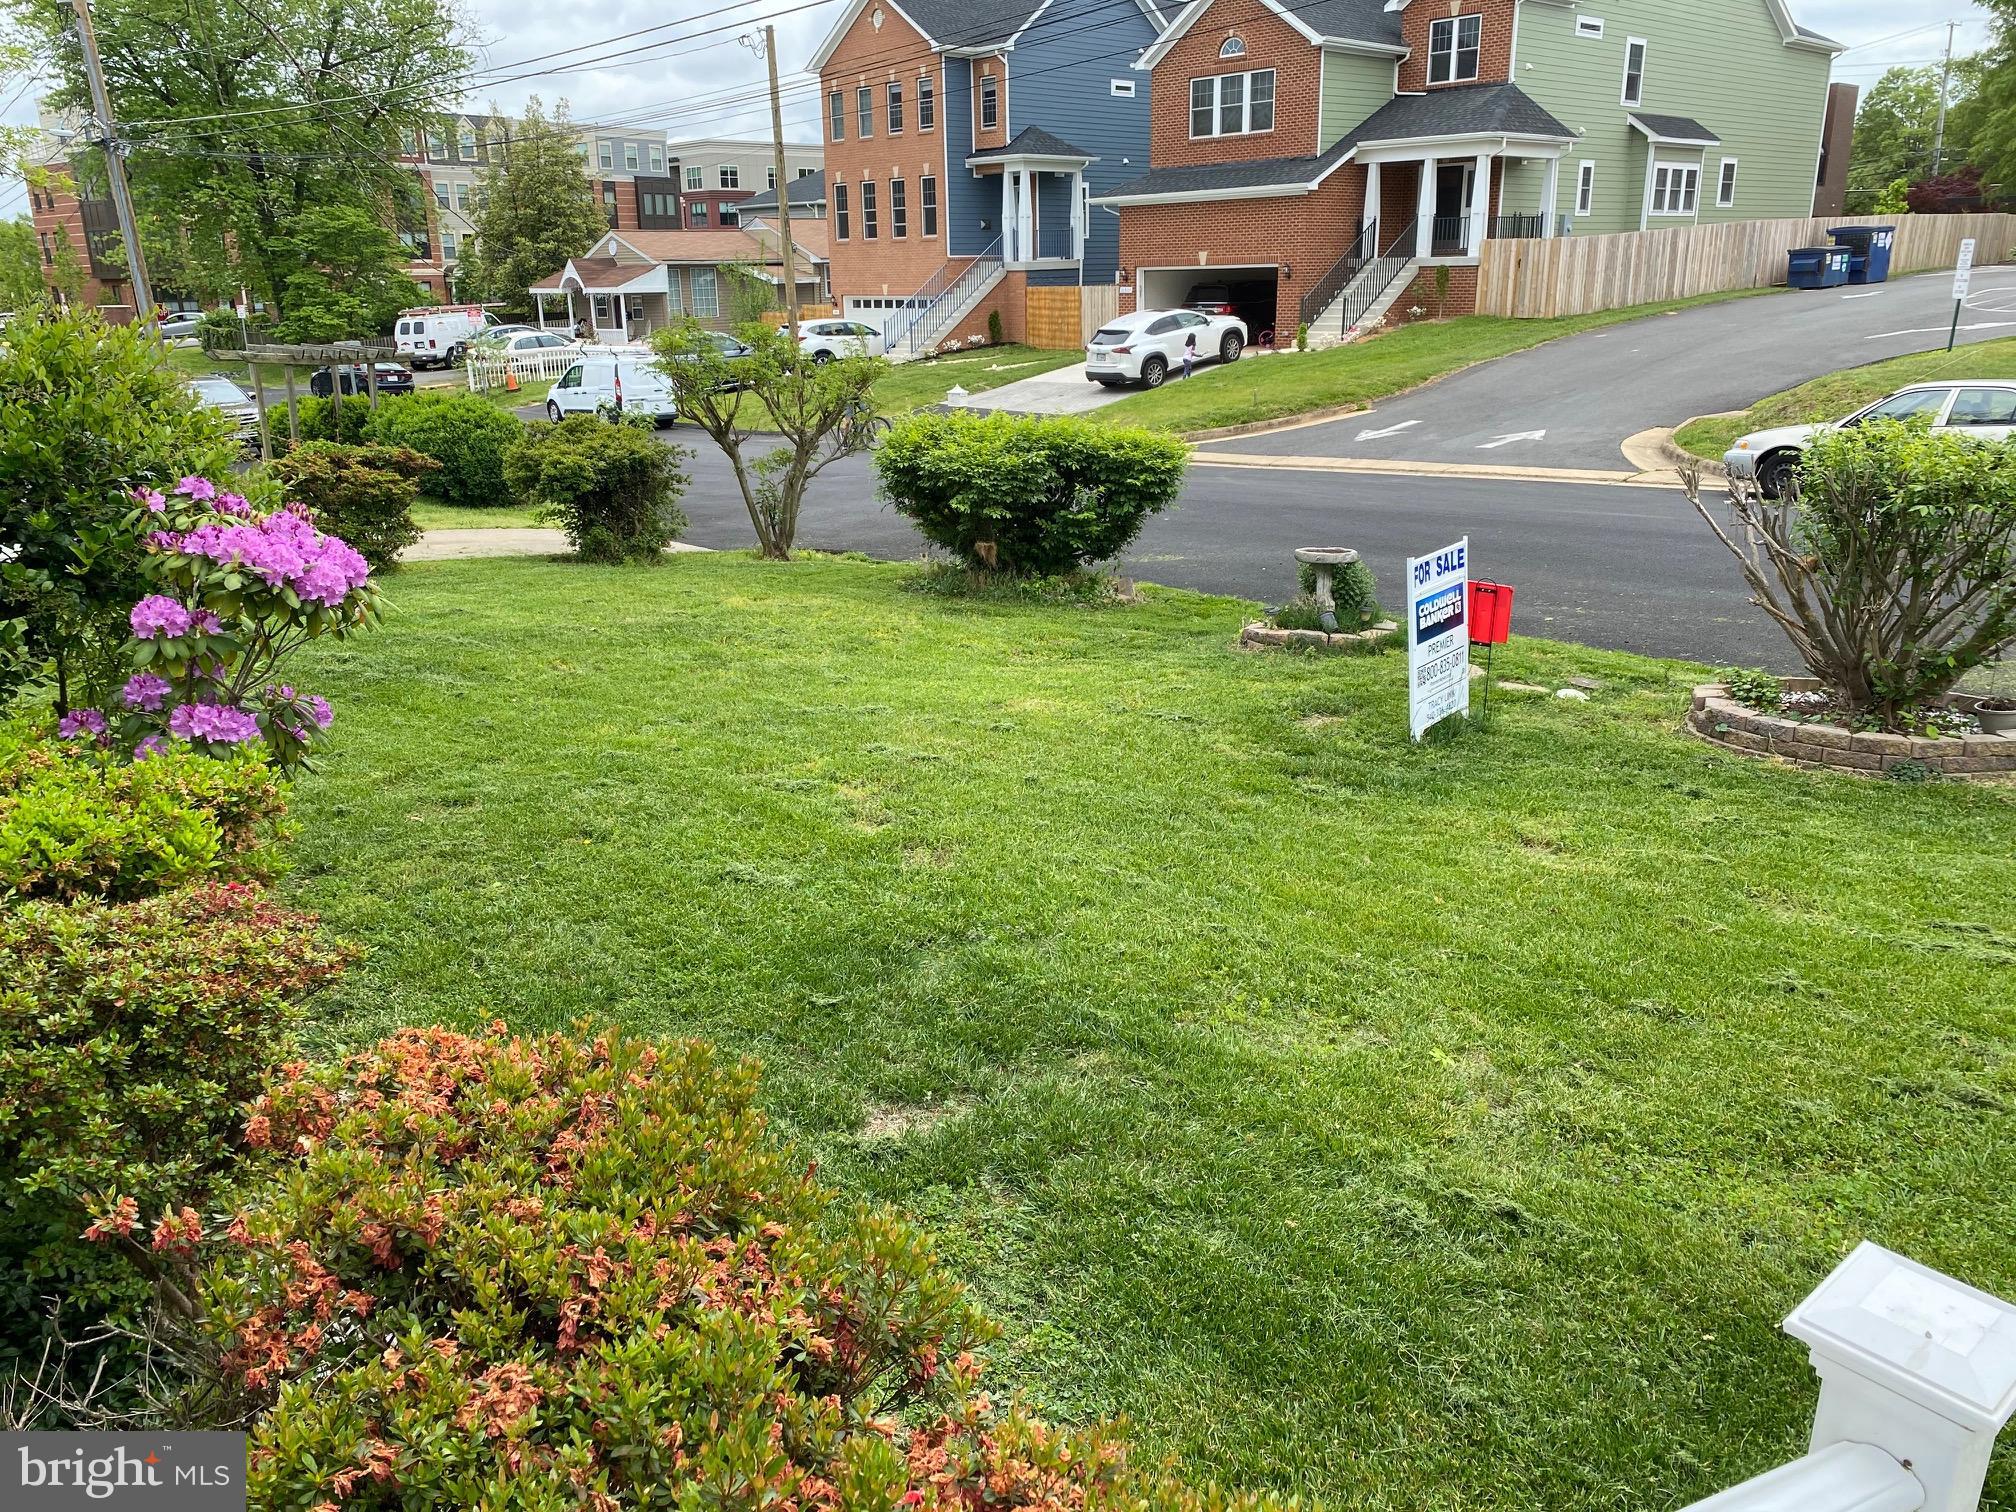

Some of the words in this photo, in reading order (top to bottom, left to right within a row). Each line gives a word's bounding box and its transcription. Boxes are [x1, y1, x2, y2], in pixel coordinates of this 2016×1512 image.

[1414, 561, 1430, 588] FOR
[1436, 548, 1464, 576] SALE
[1428, 635, 1454, 656] PREMIER
